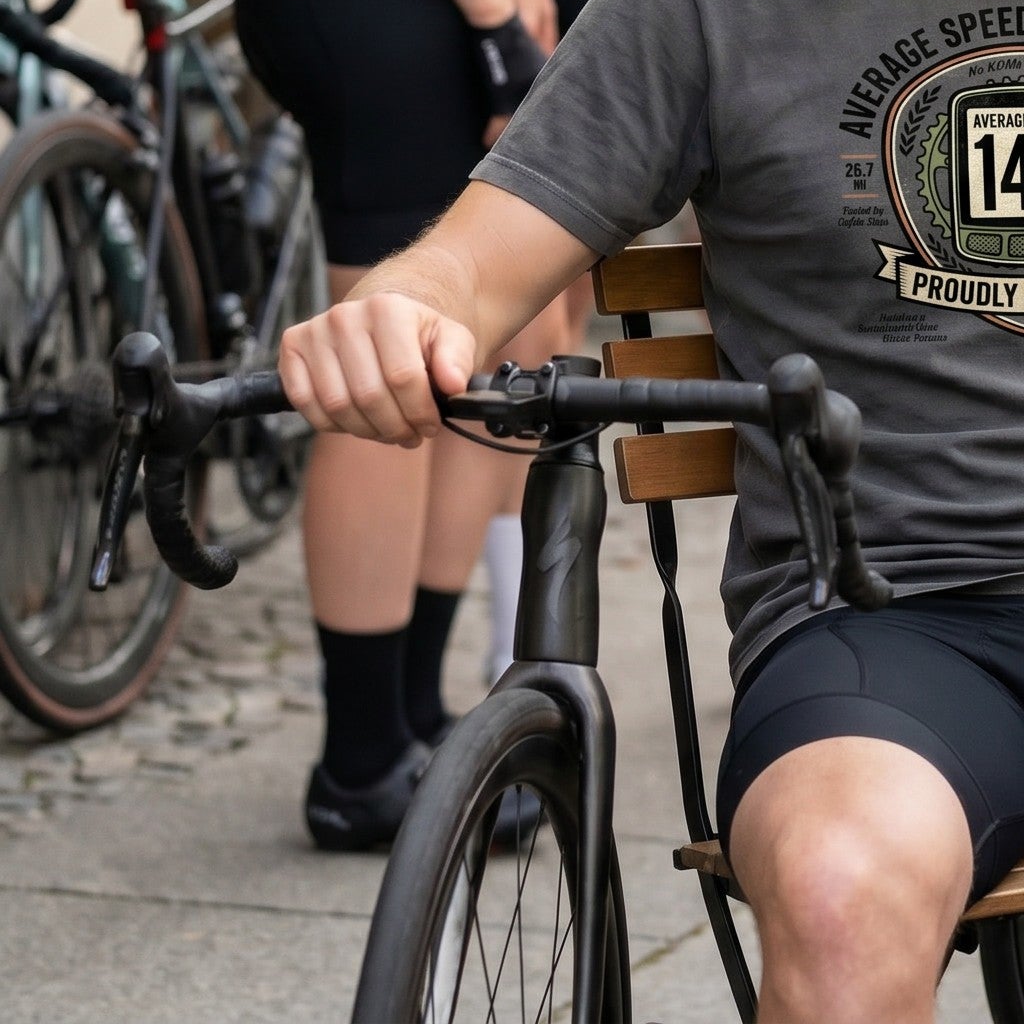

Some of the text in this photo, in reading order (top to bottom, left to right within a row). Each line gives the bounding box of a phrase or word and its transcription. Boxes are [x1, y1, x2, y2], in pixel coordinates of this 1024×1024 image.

[839, 27, 939, 139] AVERAGE
[845, 162, 874, 178] 26.7
[912, 272, 1018, 308] PROUDLY
